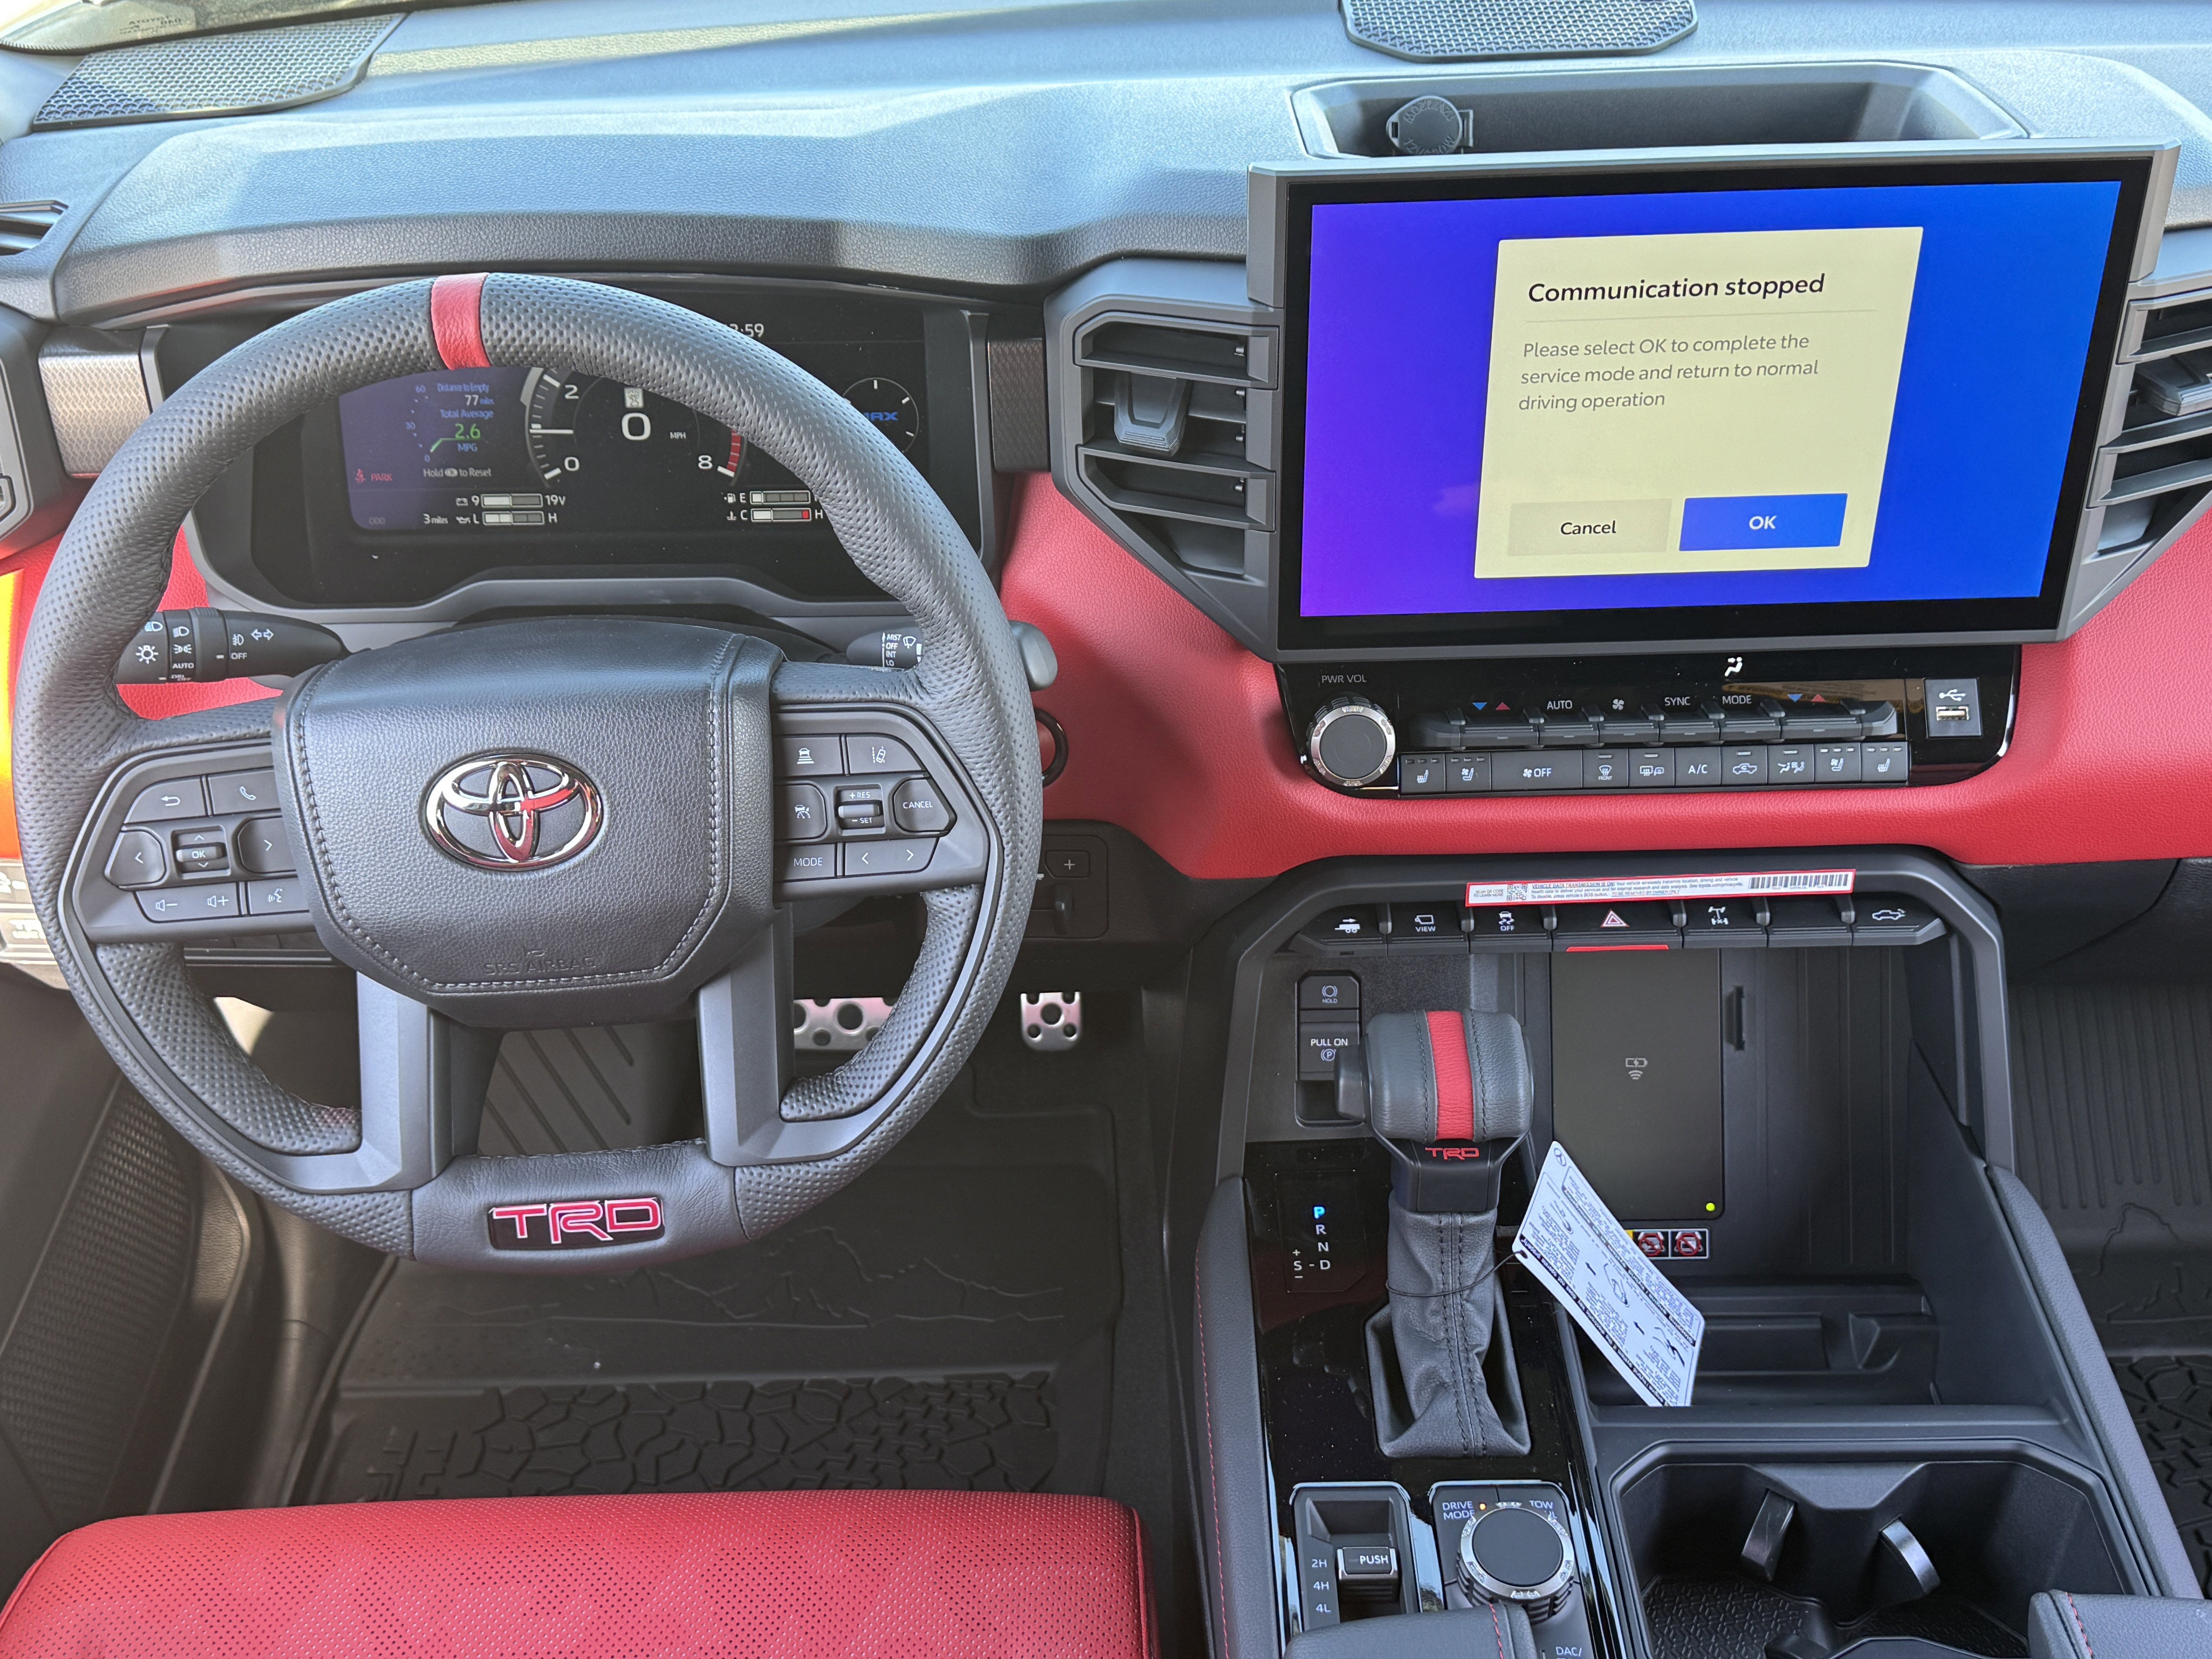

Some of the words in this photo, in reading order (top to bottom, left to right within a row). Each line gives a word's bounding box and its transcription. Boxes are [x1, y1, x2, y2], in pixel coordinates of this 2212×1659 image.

[1528, 278, 1718, 302] Communication
[1724, 273, 1825, 299] stopped
[1523, 342, 1579, 358] Please
[1583, 340, 1635, 356] select
[1639, 338, 1667, 354] OK
[1671, 338, 1689, 353] to
[1692, 335, 1777, 355] complete
[1780, 334, 1810, 349] the
[1521, 368, 1581, 385] service
[1584, 366, 1635, 382] mode
[1638, 364, 1672, 380] and
[1676, 363, 1730, 379] return
[1733, 362, 1752, 378] to
[1755, 359, 1819, 376] normal
[416, 385, 426, 393] 60
[437, 383, 462, 392] Distance
[470, 383, 489, 393] Empty
[564, 385, 579, 399] 2
[464, 395, 479, 406] 77
[1518, 394, 1578, 413] driving
[1581, 393, 1666, 411] operation
[440, 409, 460, 418] Total
[461, 409, 494, 419] Average
[455, 423, 481, 439] 2.6
[621, 412, 651, 441] 0
[670, 431, 687, 440] MPH
[457, 443, 478, 452] MPG
[564, 456, 580, 471] 0
[698, 455, 713, 470] 8
[423, 469, 444, 477] Hold
[459, 469, 468, 477] to
[469, 468, 492, 477] Reset
[471, 495, 480, 506] 9
[544, 495, 566, 506] 19V
[739, 493, 747, 503] E
[423, 514, 431, 524] 3
[431, 515, 449, 524] miles
[473, 514, 480, 524] L
[548, 512, 558, 523] H
[740, 510, 748, 520] C
[815, 510, 824, 520] H
[1560, 520, 1617, 535] Cancel
[1748, 515, 1777, 531] OK
[231, 652, 248, 660] OFF
[1321, 675, 1345, 684] PWR
[1346, 674, 1367, 683] VOL
[1547, 700, 1573, 710] AUTO
[1664, 696, 1691, 706] SYNC
[1722, 695, 1752, 705] MODE
[1533, 768, 1552, 778] OFF
[1688, 764, 1708, 775] A/C
[903, 801, 934, 809] CANCEL
[192, 850, 206, 859] OK
[793, 857, 823, 867] MODE
[483, 962, 520, 975] SRS
[526, 956, 597, 973] AIRBAG
[1310, 1038, 1332, 1046] PULL
[1333, 1038, 1348, 1046] ON
[1425, 1147, 1480, 1161] TRD
[1313, 1206, 1326, 1219] P
[492, 1199, 661, 1244] TRD
[1316, 1224, 1327, 1235] R
[1318, 1242, 1329, 1252] N
[1293, 1260, 1303, 1271] S
[1319, 1259, 1331, 1270] D
[1442, 1501, 1474, 1511] DRIVE
[1529, 1500, 1554, 1510] TOW
[1443, 1510, 1475, 1521] MODE
[1311, 1558, 1328, 1568] 2H
[1359, 1554, 1389, 1565] PUSH
[1313, 1581, 1330, 1590] 4H
[1316, 1604, 1331, 1613] 4L
[1555, 1646, 1582, 1657] DAC/
